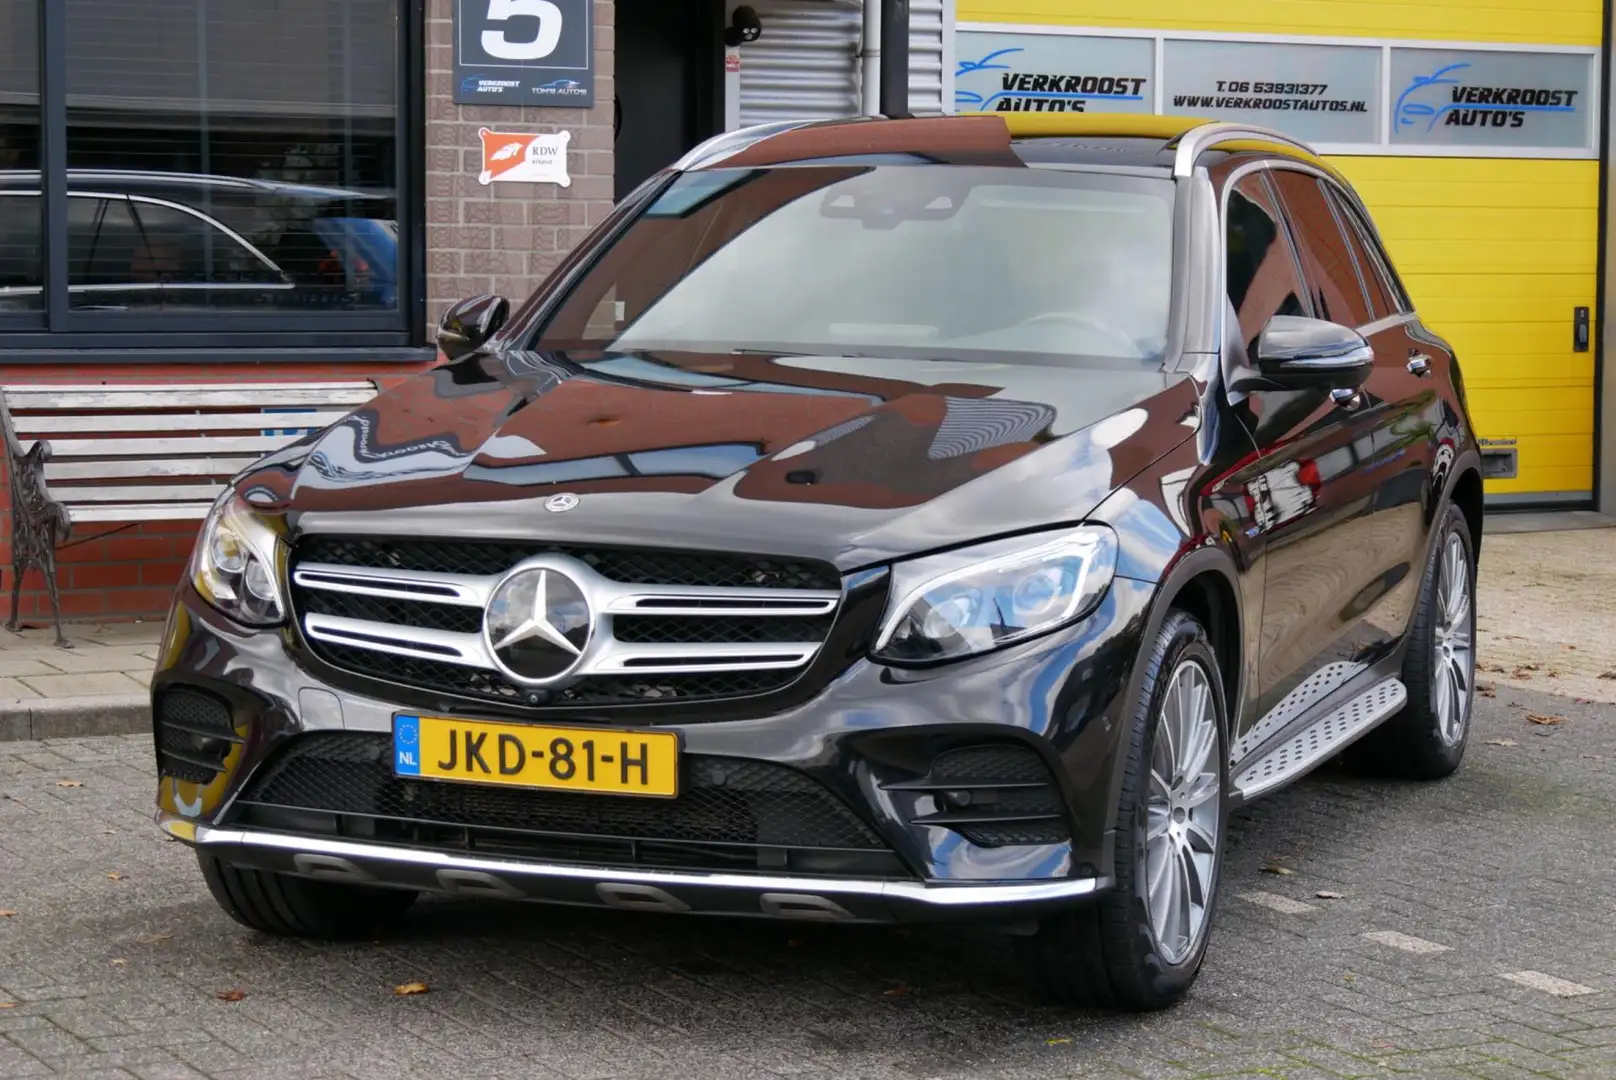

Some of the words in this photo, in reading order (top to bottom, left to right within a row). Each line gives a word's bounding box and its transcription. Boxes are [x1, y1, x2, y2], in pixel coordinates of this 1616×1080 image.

[1002, 73, 1147, 96] VERKROOST
[1228, 81, 1249, 93] 06
[1253, 83, 1328, 95] 53931377
[995, 97, 1086, 112] AUTO'S
[1173, 95, 1368, 113] WWW.VERKROOSTAUTOS.NL
[1452, 86, 1578, 107] VERKROOST
[1445, 110, 1525, 127] AUTO'S
[532, 146, 558, 156] RDW
[399, 751, 417, 766] NL
[437, 728, 648, 786] JKD-81-H
